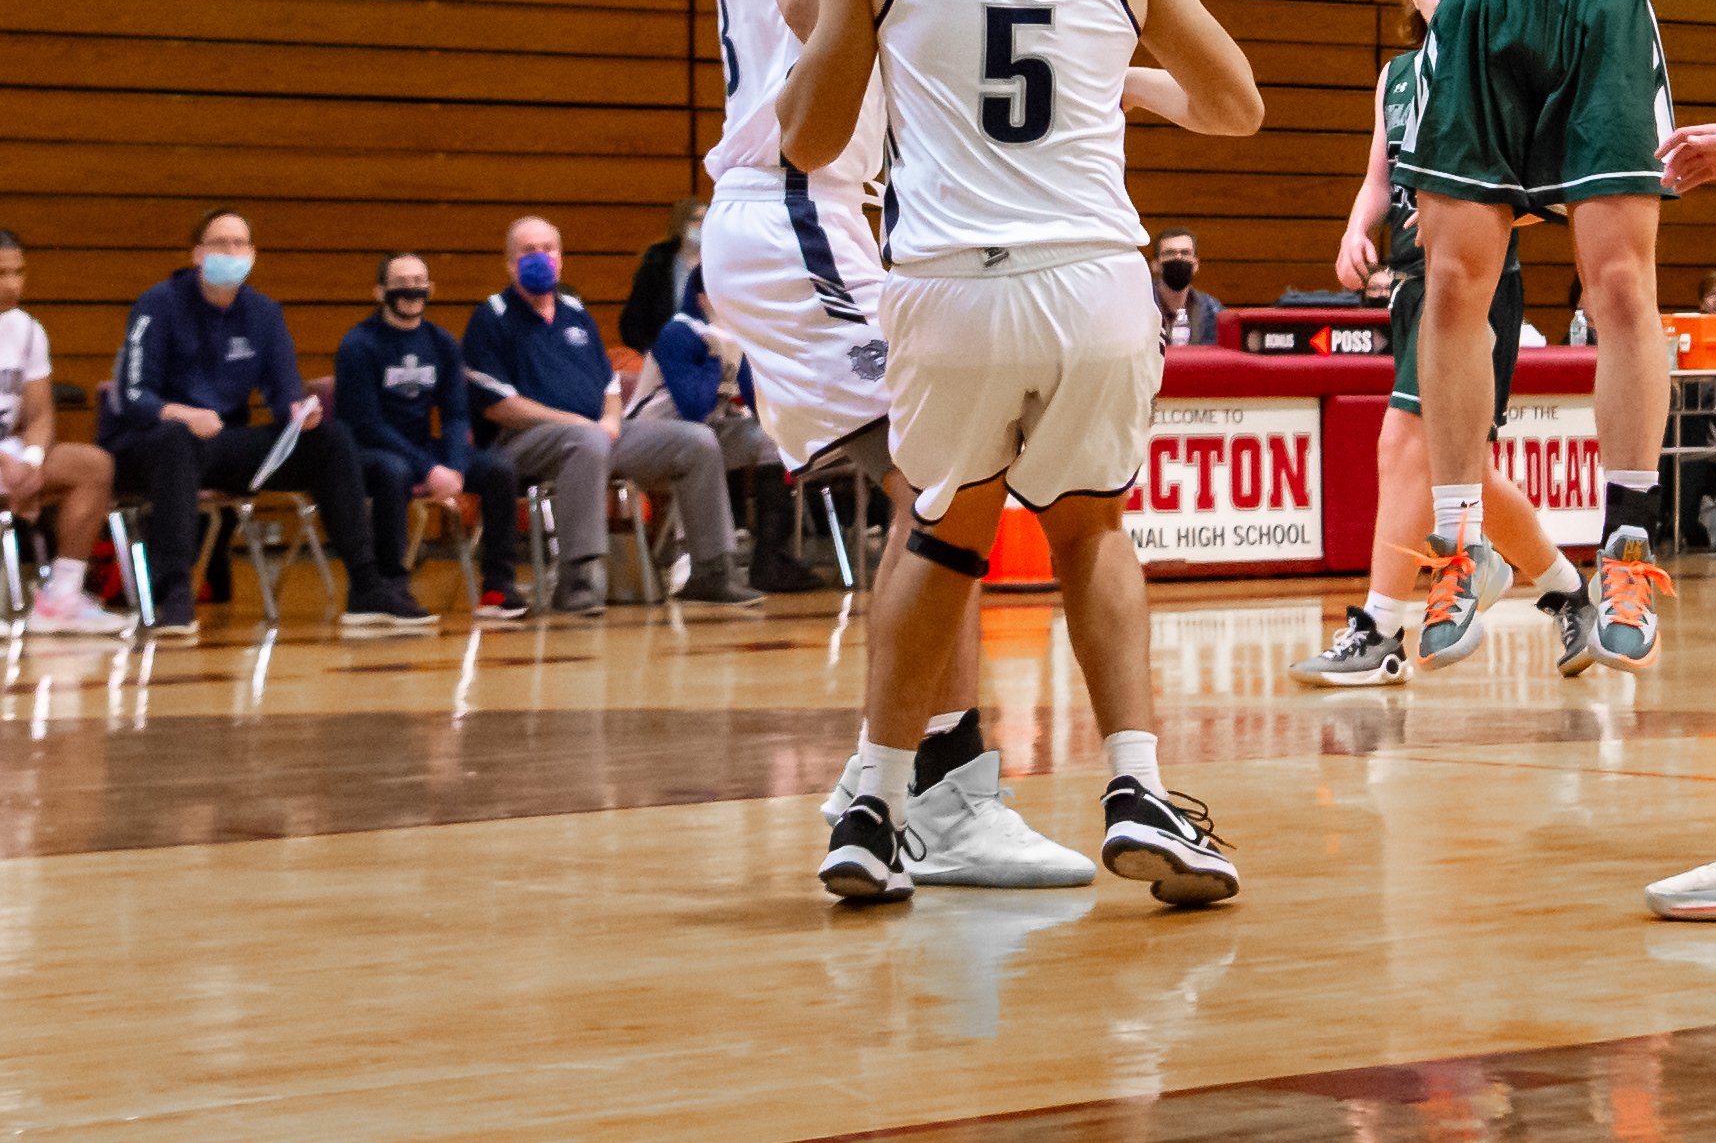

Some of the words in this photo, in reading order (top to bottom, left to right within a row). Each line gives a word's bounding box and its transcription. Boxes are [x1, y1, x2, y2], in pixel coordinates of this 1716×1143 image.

[977, 3, 1057, 148] 5
[1331, 329, 1373, 353] POSS
[1153, 409, 1217, 424] ELCOME
[1225, 409, 1244, 424] TO
[1508, 405, 1525, 420] OF
[1533, 405, 1559, 420] THE
[1123, 432, 1312, 514] CTON
[1177, 525, 1226, 548] HIGH
[1233, 523, 1311, 546] SCHOOL
